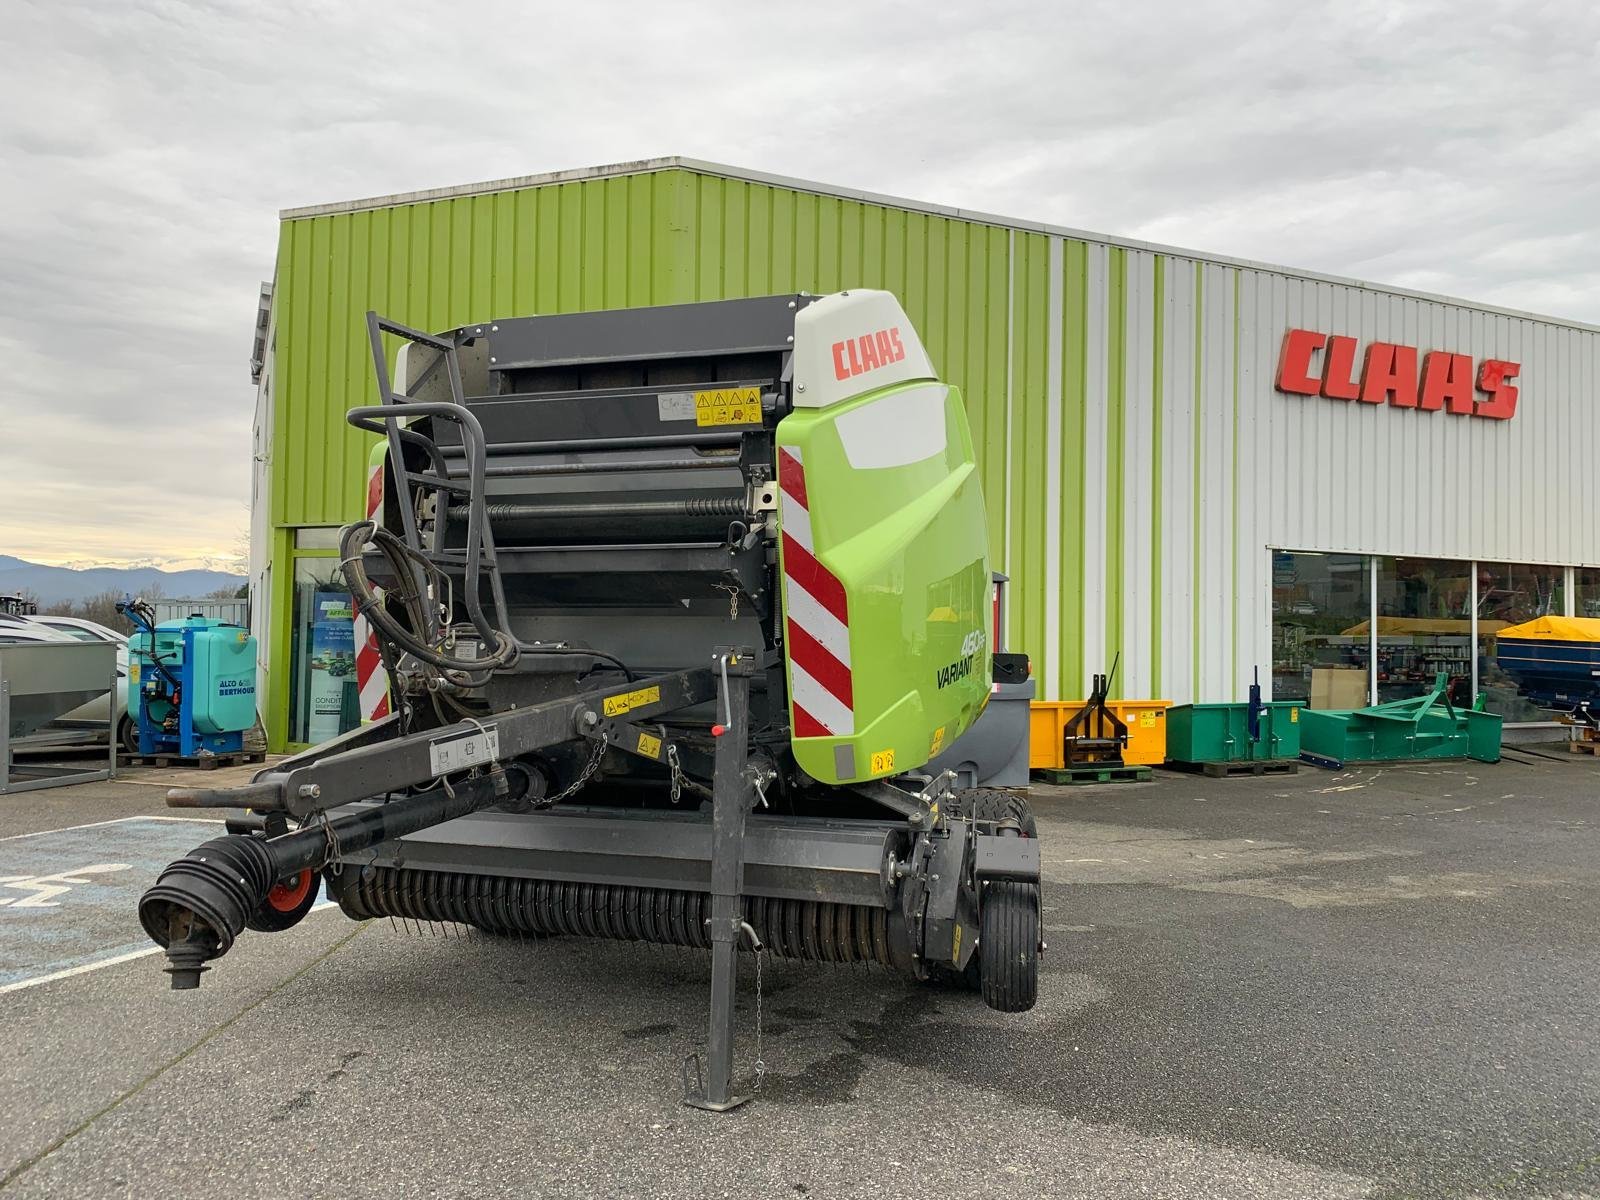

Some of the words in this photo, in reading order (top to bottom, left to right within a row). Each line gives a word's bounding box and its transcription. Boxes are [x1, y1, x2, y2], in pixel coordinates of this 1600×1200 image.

[832, 327, 905, 381] CLAAS
[1274, 328, 1521, 421] CLAAS
[219, 687, 255, 696] BERTHOUD
[937, 655, 974, 690] VARIANT
